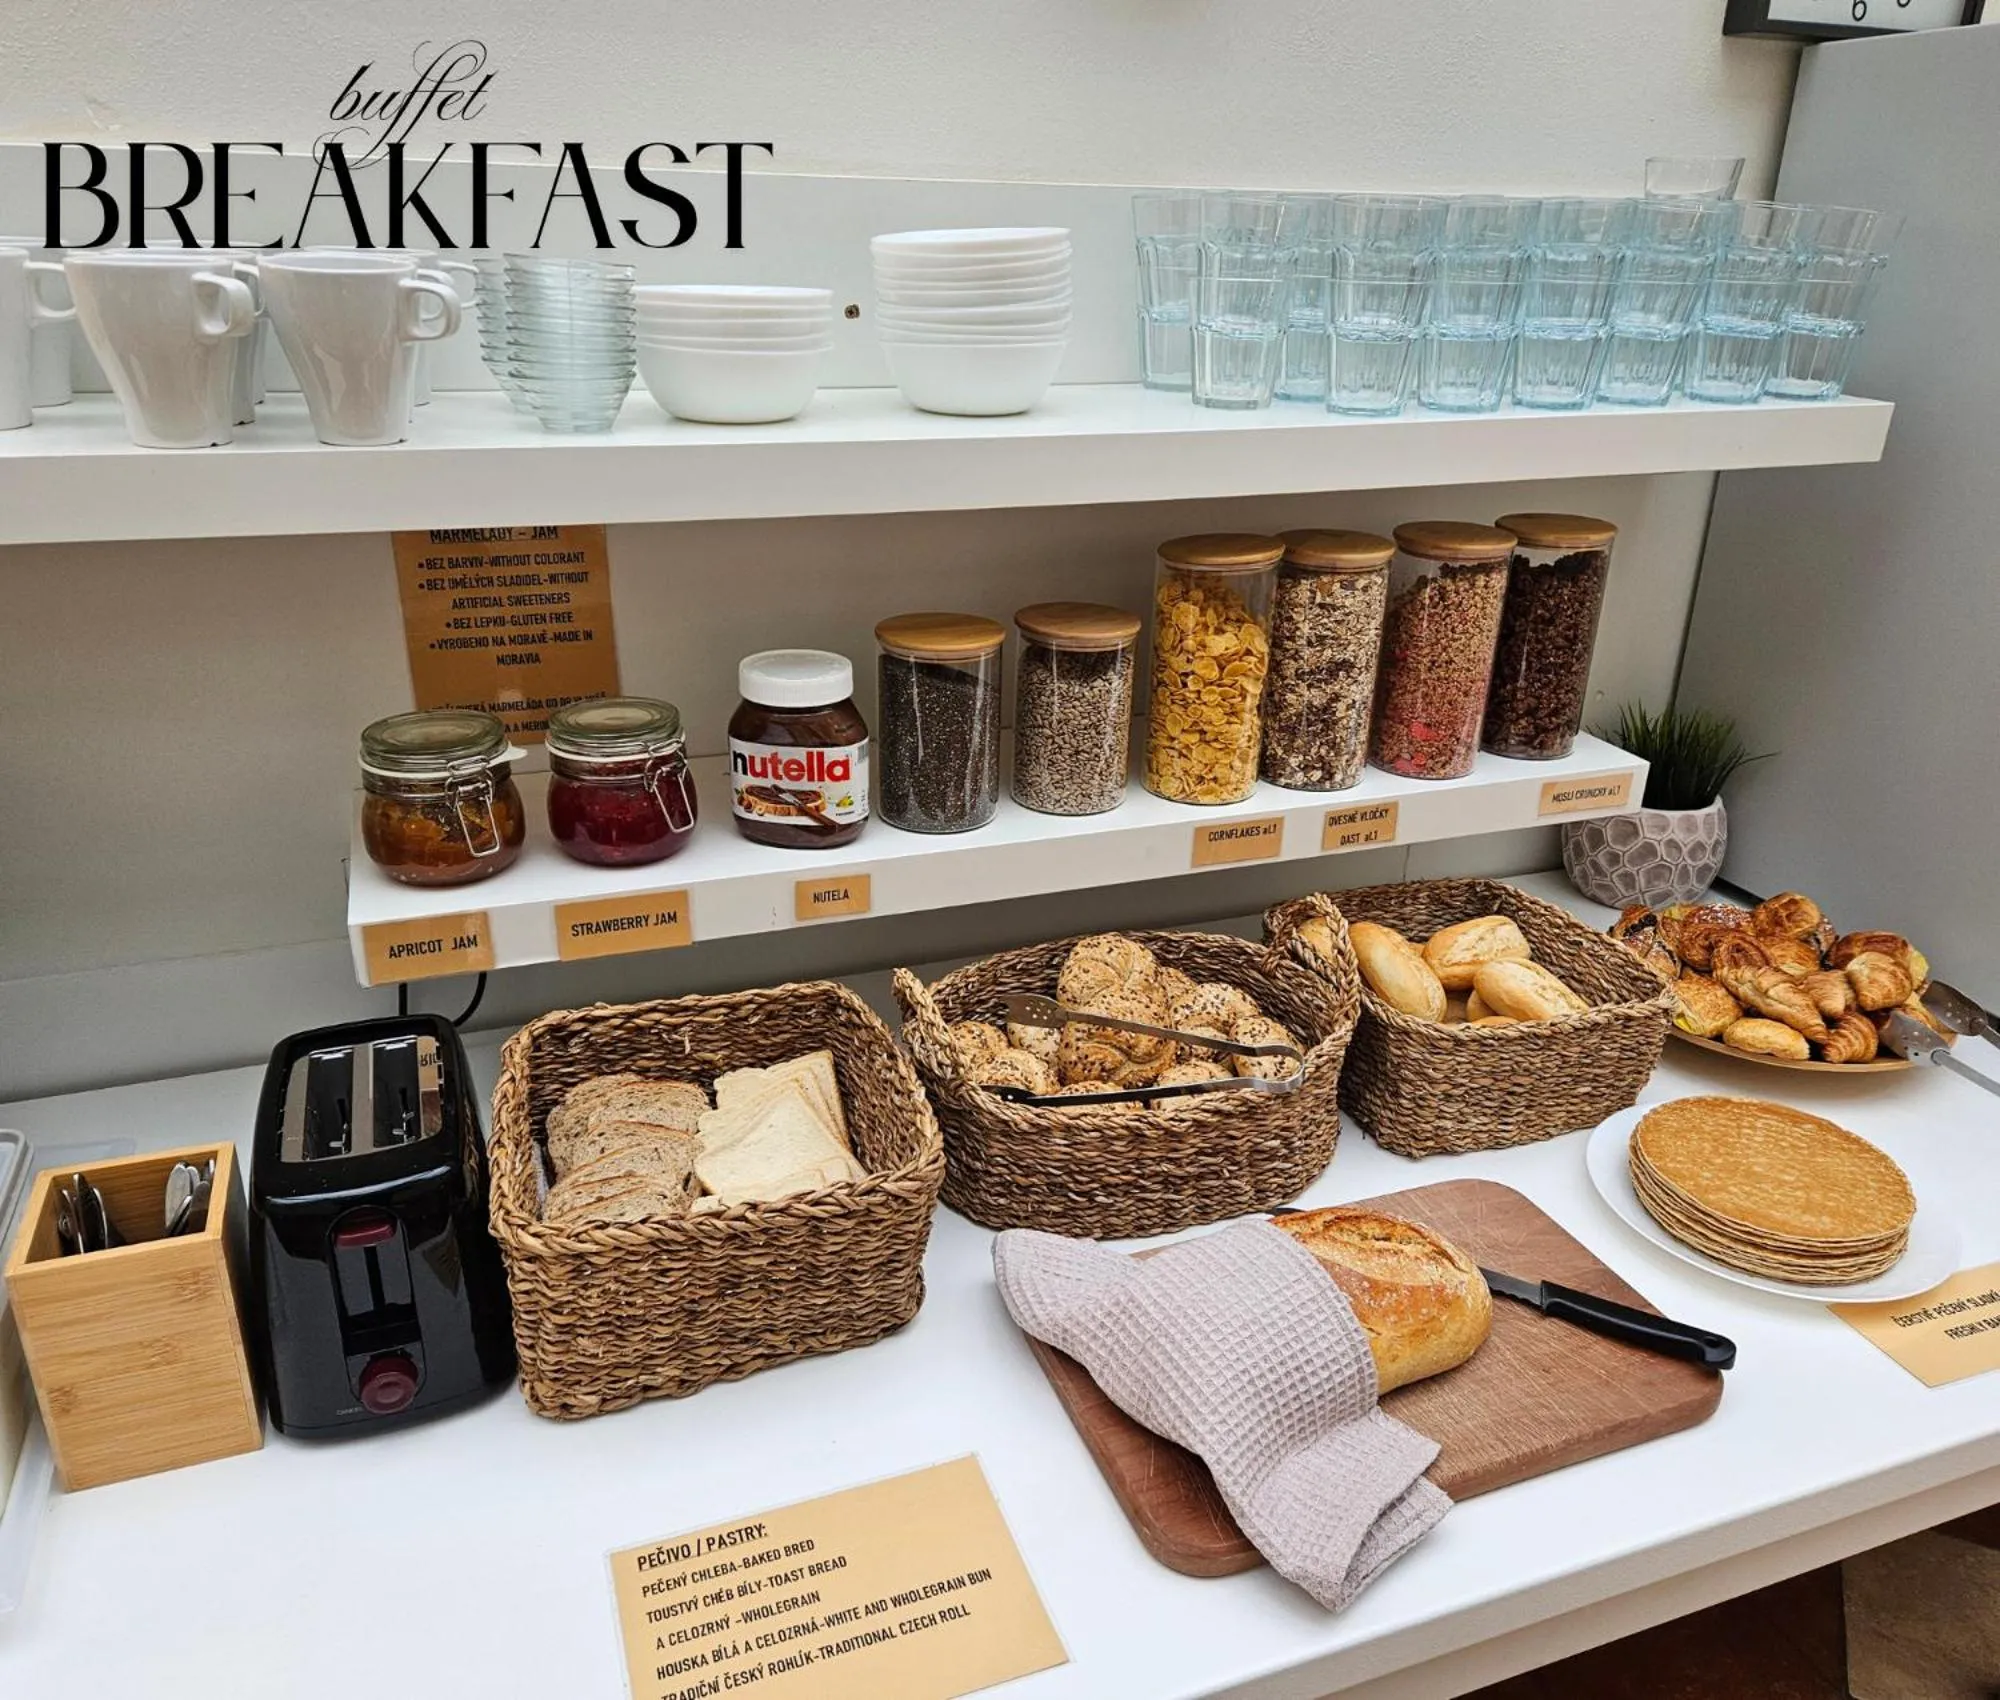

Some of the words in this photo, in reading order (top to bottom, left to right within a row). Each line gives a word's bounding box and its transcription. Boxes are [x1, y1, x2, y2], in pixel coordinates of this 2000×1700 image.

[1852, 0, 1867, 21] 6
[531, 526, 558, 540] JAM
[425, 557, 445, 570] BEZ
[534, 551, 585, 565] COLORANT
[426, 577, 446, 591] BEZ
[452, 595, 504, 610] ARTIFICIAL
[507, 592, 571, 607] SWEETENERS
[452, 617, 472, 630] BEZ
[474, 613, 547, 629] LEPKU-GLUTEN
[549, 611, 574, 624] FREE
[437, 636, 489, 650] VYROBENO
[492, 635, 505, 647] NA
[583, 629, 593, 641] IN
[496, 652, 542, 667] MORAVIA
[732, 750, 852, 783] nutella
[1328, 811, 1358, 827] OVESNÉ
[1208, 826, 1261, 843] CORNFLAKES
[813, 888, 850, 904] NUTELA
[571, 912, 650, 939] STRAWBERRY
[653, 911, 678, 927] JAM
[388, 938, 444, 959] APRICOT
[451, 934, 478, 952] JAM
[1944, 1320, 1989, 1341] FRESHLY
[637, 1544, 691, 1571] PEČIVO
[696, 1538, 701, 1557] /
[706, 1523, 769, 1551] PASTRY:
[642, 1572, 688, 1598] PEČENÝ
[691, 1548, 781, 1584] CHLEBA-BAKED
[784, 1539, 815, 1558] BRED
[646, 1594, 699, 1625] TOUSTVÝ
[808, 1555, 848, 1578] BREAD
[656, 1637, 665, 1651] A
[668, 1613, 731, 1647] CELOZRNÝ
[735, 1590, 821, 1625] -WHOLEGRAIN
[656, 1653, 709, 1681] HOUSKA
[712, 1640, 740, 1663] BÍLÁ
[744, 1640, 753, 1654] A
[755, 1606, 862, 1650] CELOZRNÁ-WHITE
[864, 1599, 889, 1617] AND
[890, 1575, 967, 1608] WHOLEGRAIN
[967, 1568, 992, 1586] BUN
[724, 1662, 765, 1690] ČESKÝ
[767, 1626, 897, 1677] ROHLÍK-TRADITIONAL
[899, 1613, 937, 1636] CZECH
[939, 1603, 971, 1624] ROLL
